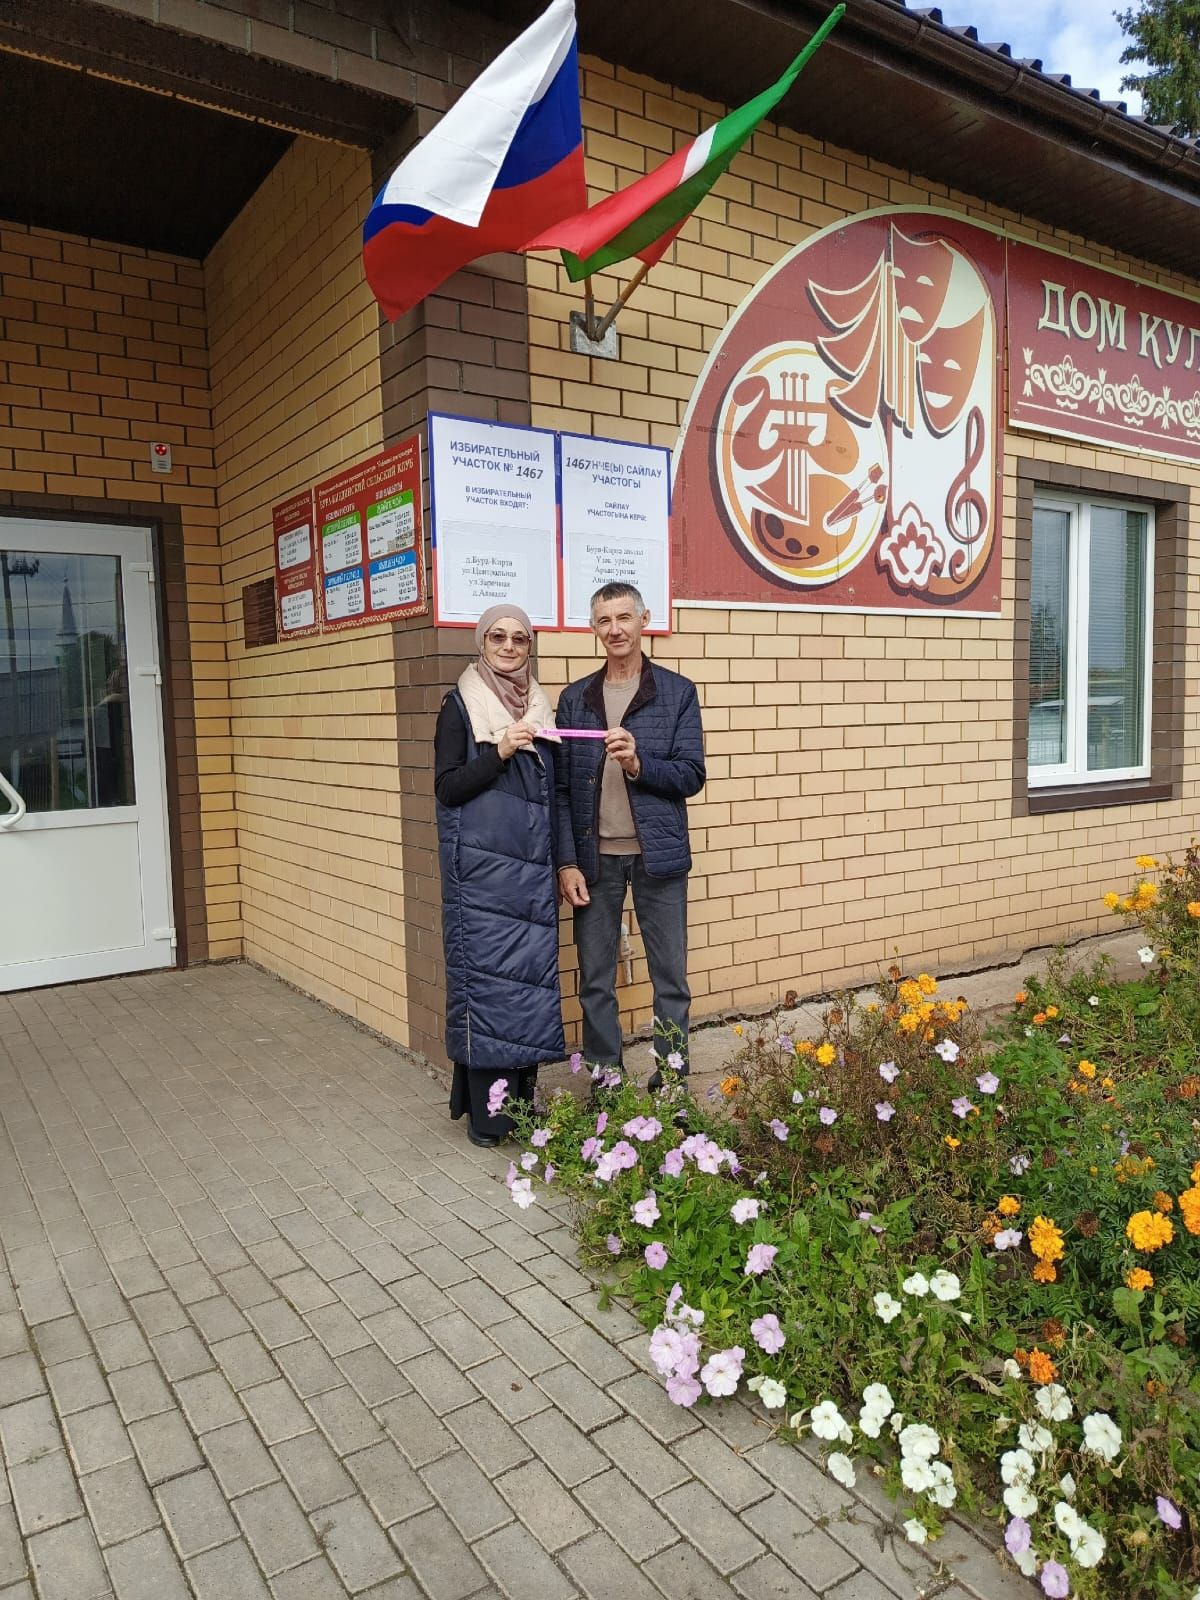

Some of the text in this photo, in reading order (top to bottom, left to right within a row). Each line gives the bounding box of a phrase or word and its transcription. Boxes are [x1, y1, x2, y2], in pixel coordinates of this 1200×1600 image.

[1037, 279, 1128, 353] ДОМ
[450, 440, 540, 462] ИЗБИРАТЕЛЬНЫЙ
[397, 458, 414, 473] КЛУБ
[452, 455, 501, 472] УЧАСТОК
[503, 462, 513, 473] №
[516, 465, 544, 480] 1467
[626, 464, 662, 478] САЙЛАУ
[592, 474, 641, 488] УЧАСТОГЫ
[465, 486, 532, 501] В ИЗБИРАТЕЛЬНЫЙ
[465, 496, 529, 509] УЧАСТОК ВХОДЯТ:
[604, 501, 629, 510] САЙЛАУ
